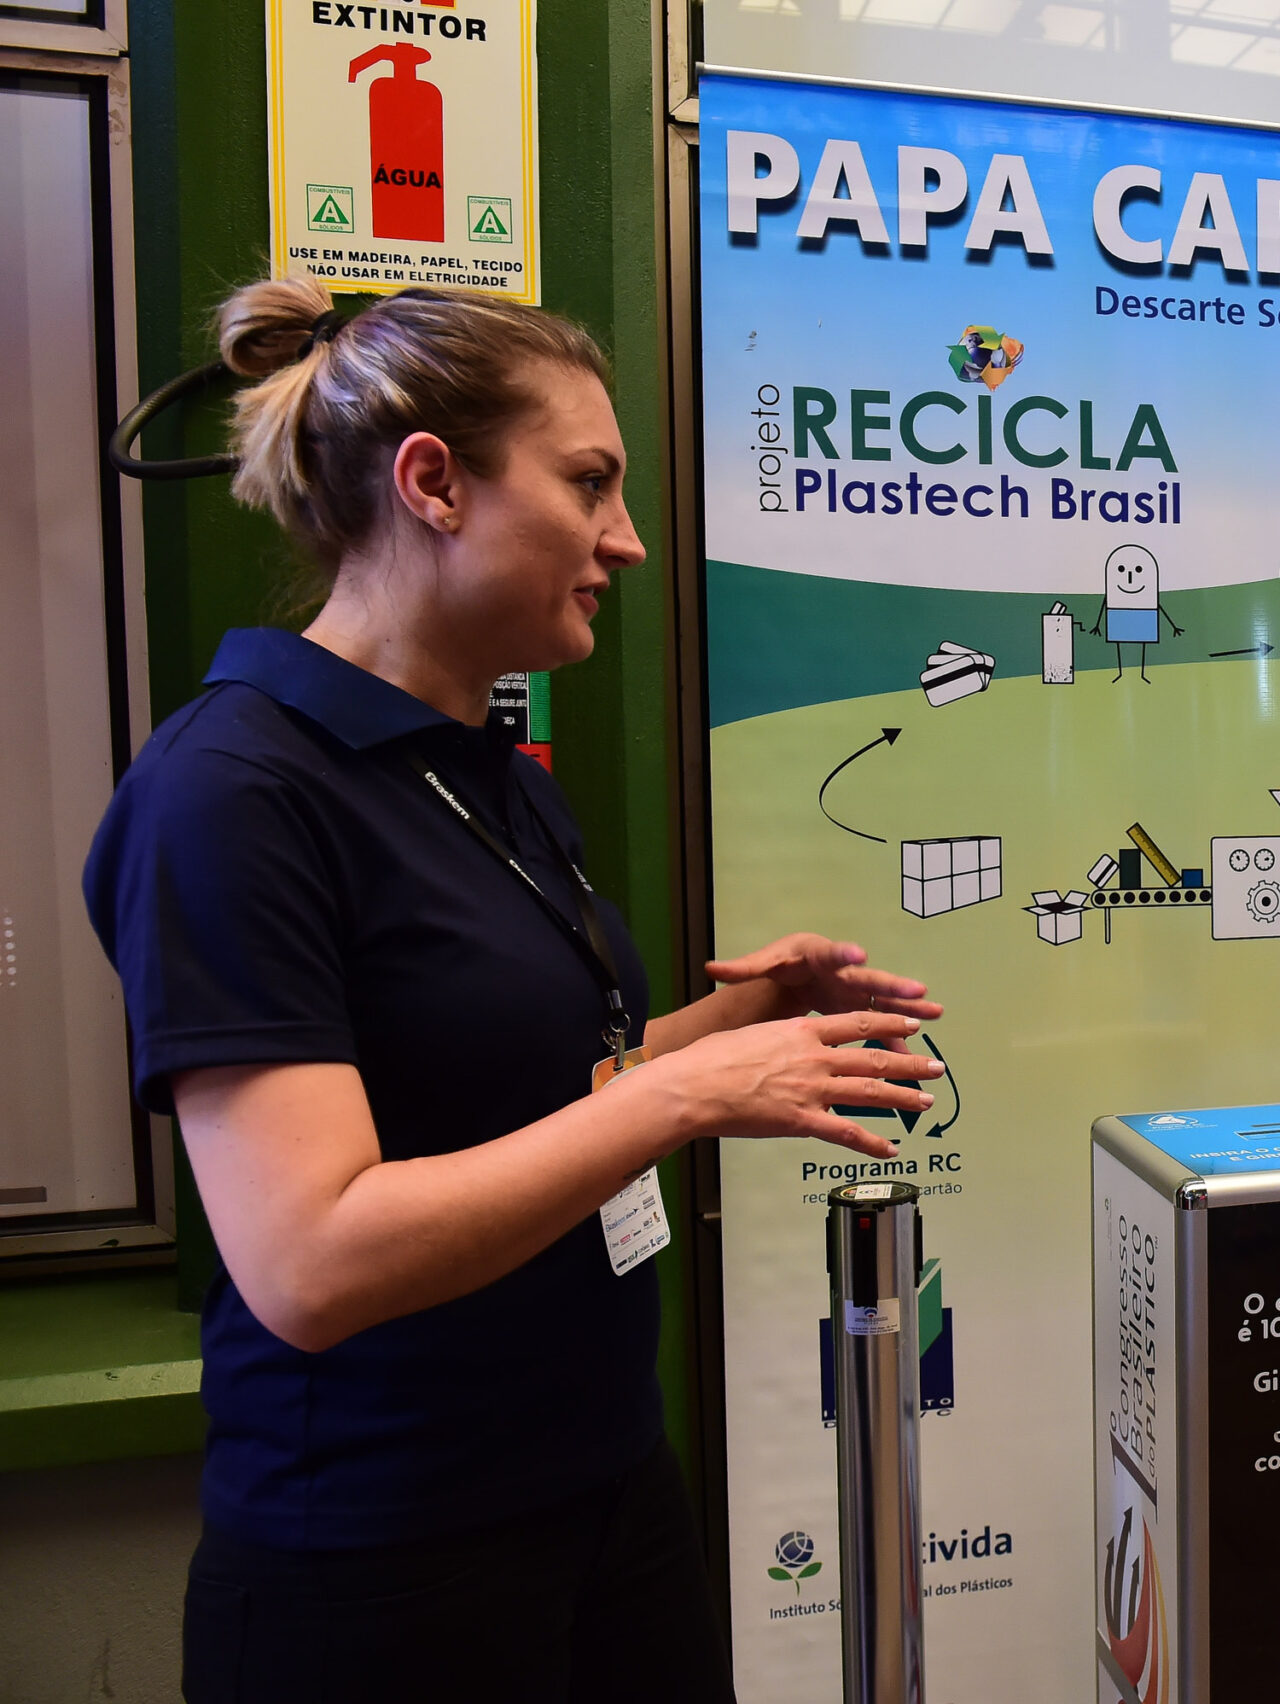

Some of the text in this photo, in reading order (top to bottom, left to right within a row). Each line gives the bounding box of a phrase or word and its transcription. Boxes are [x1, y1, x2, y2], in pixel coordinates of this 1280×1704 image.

[312, 0, 487, 42] EXTINTOR
[373, 163, 442, 189] ÁGUA
[726, 129, 1054, 256] PAPA
[321, 199, 342, 223] A
[482, 211, 500, 234] A
[289, 247, 524, 273] USE EM MADEIRA, PAPEL, TECIDO
[306, 262, 508, 288] NÃO USAR EM ELETRICIDADE
[1095, 286, 1246, 326] Descarte
[750, 383, 790, 512] projeto
[792, 386, 1180, 473] RECICLA
[795, 468, 1181, 525] Plastech Brasil
[425, 771, 471, 820] Braskem
[802, 1153, 962, 1183] Programa RC
[1190, 1149, 1252, 1160] INSIRA
[1243, 1292, 1265, 1315] O
[1118, 1214, 1132, 1443] Congresso
[1128, 1223, 1143, 1462] Brasileiro
[1143, 1233, 1156, 1446] PLÁSTICO
[1237, 1319, 1252, 1342] é
[769, 1602, 826, 1620] Instituto
[935, 1583, 958, 1597] dos
[960, 1575, 1014, 1594] Plásticos
